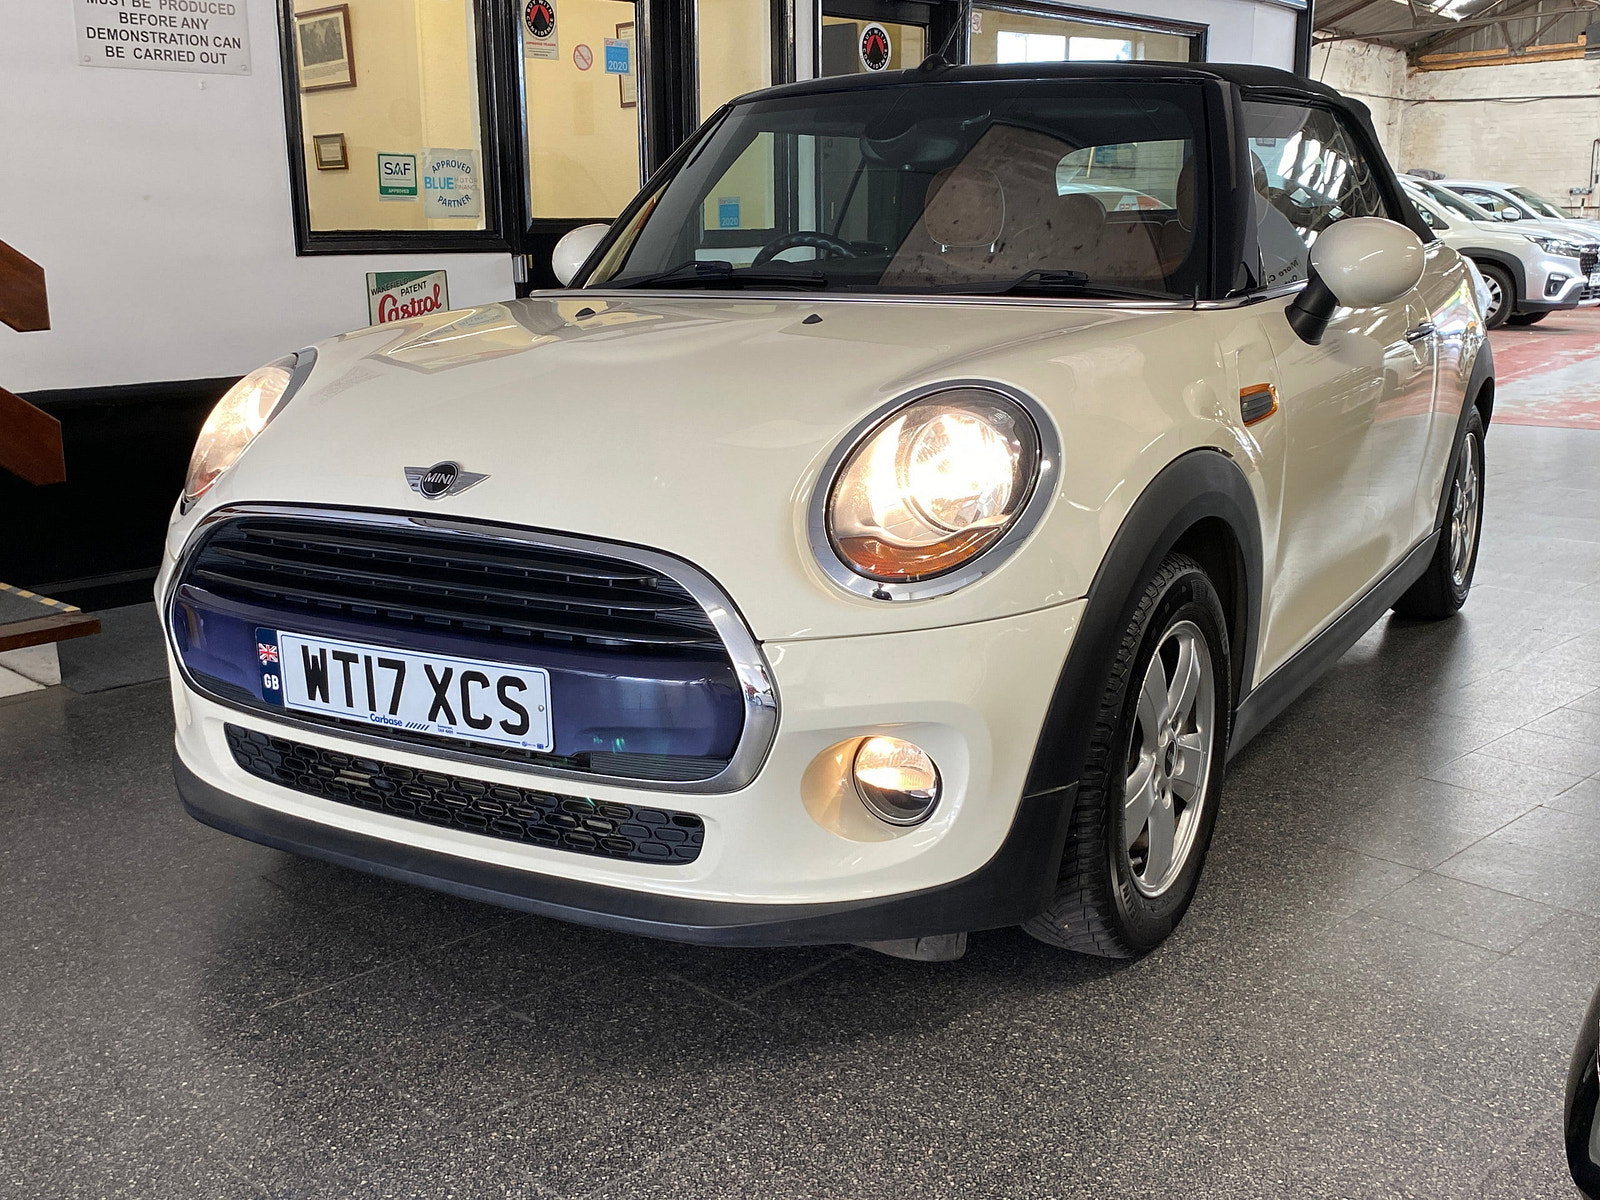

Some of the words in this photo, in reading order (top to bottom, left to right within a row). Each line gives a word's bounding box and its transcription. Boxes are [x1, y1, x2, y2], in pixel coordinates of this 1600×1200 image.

[159, 0, 236, 16] PRODUCED
[119, 12, 177, 28] BEFORE
[181, 17, 209, 31] ANY
[86, 27, 209, 47] DEMONSTRATION
[213, 37, 242, 49] CAN
[105, 46, 125, 58] BE
[133, 49, 196, 63] CARRIED
[200, 52, 228, 65] OUT
[608, 60, 628, 71] 2020
[384, 162, 412, 176] SAF
[431, 159, 472, 174] APPROVED
[424, 176, 454, 190] BLUE
[437, 194, 472, 208] PARTNER
[721, 217, 739, 227] 2020
[370, 278, 409, 296] WAKEFIELD
[400, 280, 427, 297] PATENT
[378, 283, 442, 323] Castrol
[424, 472, 455, 485] MINI
[263, 673, 280, 691] GB
[300, 644, 407, 716] WT17
[423, 663, 530, 737] XCS
[369, 713, 403, 727] Carbase
